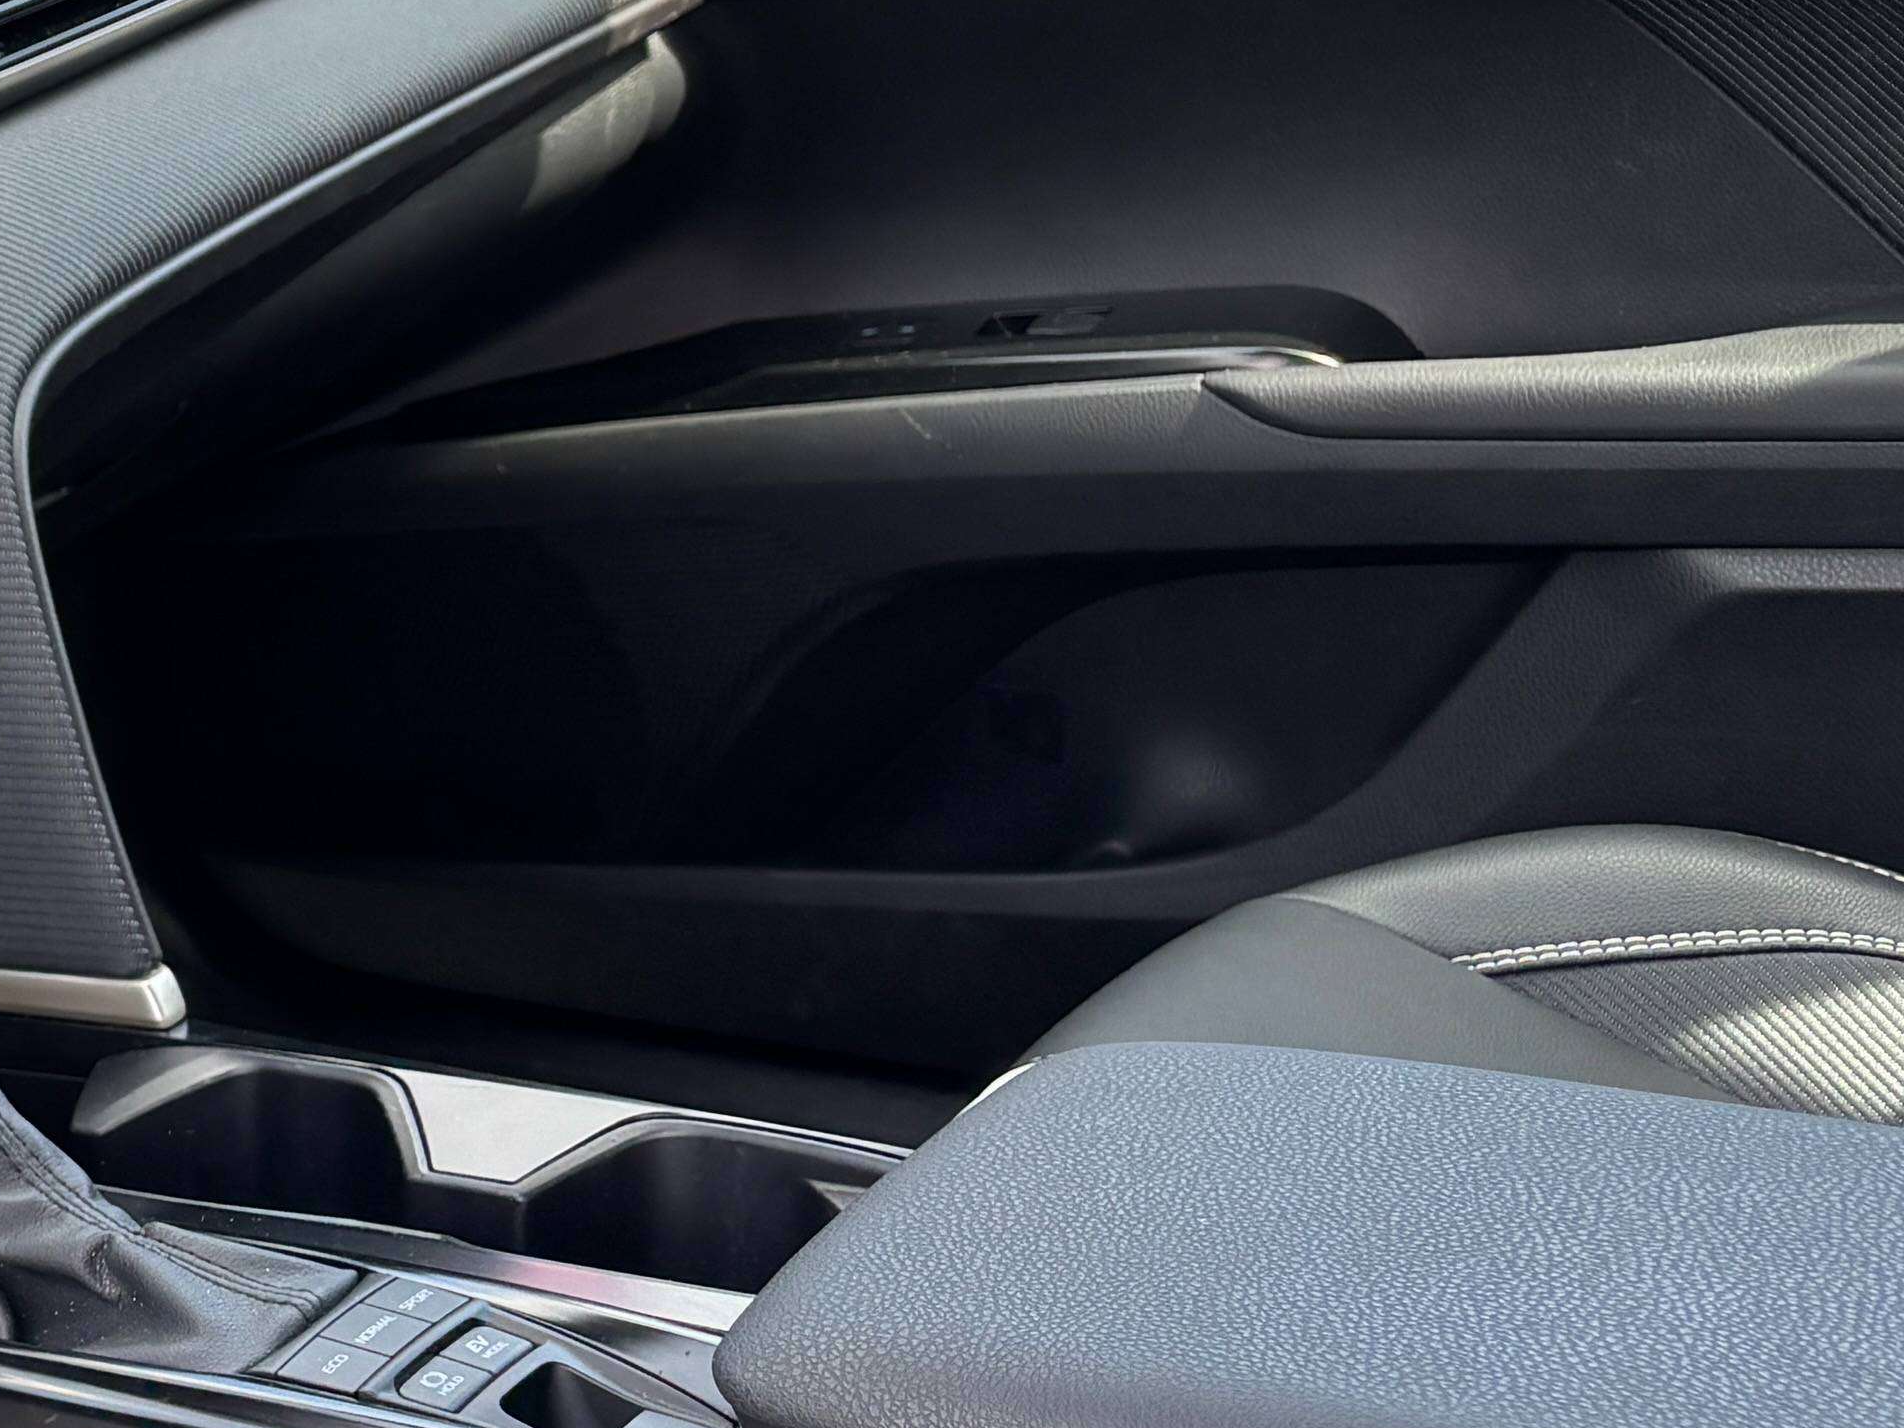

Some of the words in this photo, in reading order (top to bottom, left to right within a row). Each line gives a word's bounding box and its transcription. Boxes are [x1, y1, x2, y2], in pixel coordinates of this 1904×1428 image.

[397, 1288, 435, 1313] SPORT
[354, 1313, 398, 1346] NORMAL
[464, 1333, 491, 1355] EV
[482, 1340, 511, 1359] MODE
[321, 1353, 349, 1376] ECO
[438, 1374, 466, 1397] HOLD
